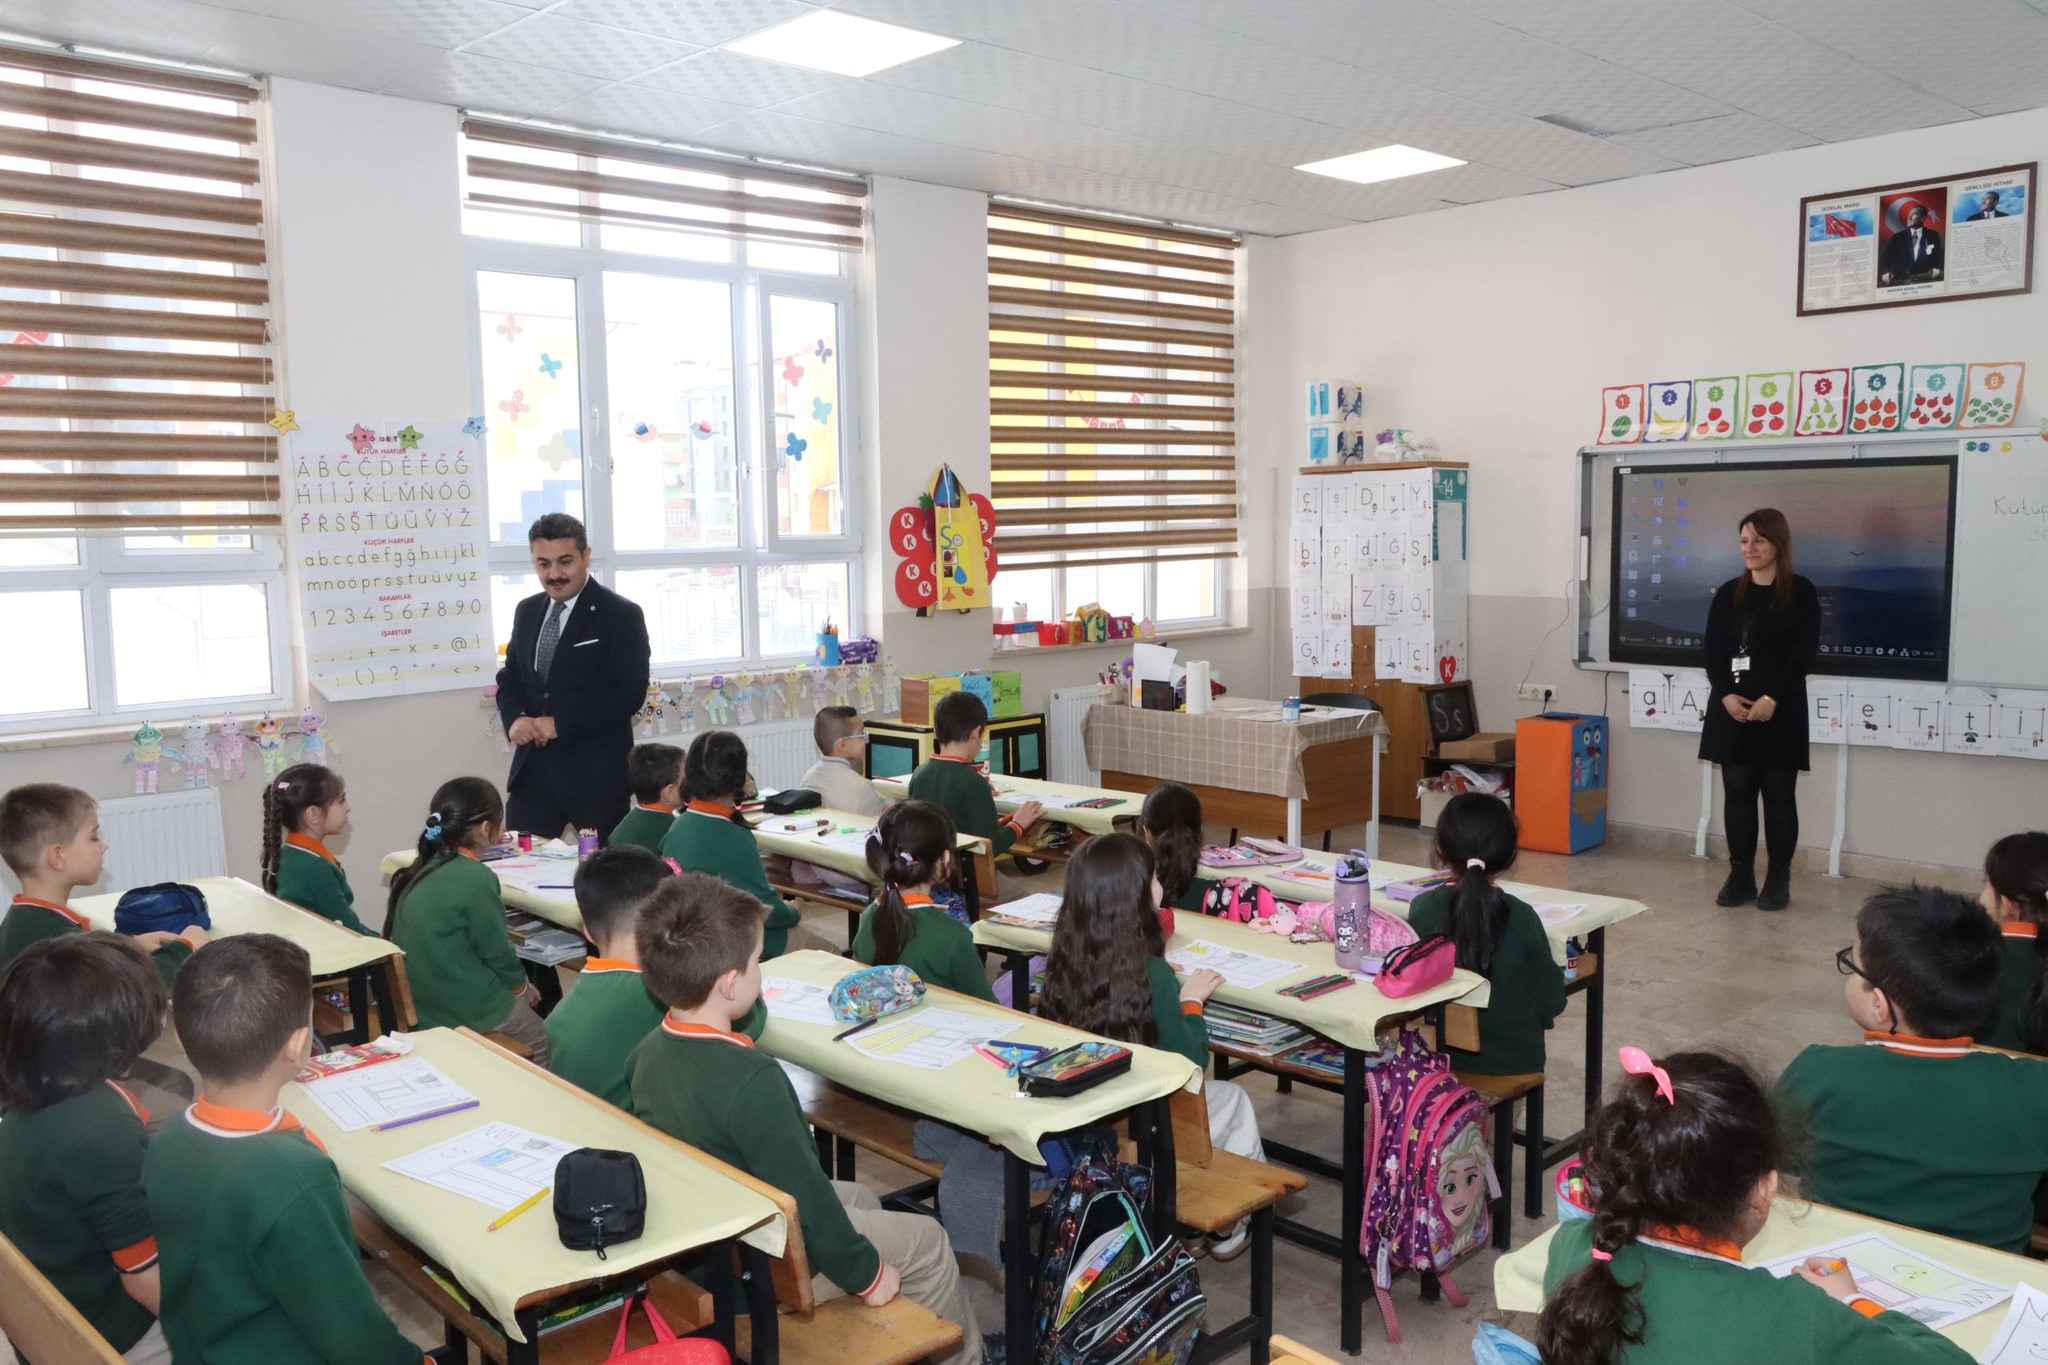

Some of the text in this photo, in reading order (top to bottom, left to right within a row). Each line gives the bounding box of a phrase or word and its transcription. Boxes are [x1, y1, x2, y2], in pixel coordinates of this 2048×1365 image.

[1820, 381, 1827, 392] 5
[1873, 378, 1881, 388] 6
[1933, 377, 1941, 387] 7
[1991, 377, 1998, 387] 8
[1712, 389, 1718, 399] 3
[1765, 385, 1772, 394] 4
[1620, 397, 1625, 406] 1
[1666, 393, 1672, 403] 2
[1443, 478, 1454, 497] 14
[1361, 487, 1373, 505] D
[1412, 487, 1421, 502] Y
[904, 515, 912, 527] K
[364, 537, 415, 546] KÜÇÜK HARFLER
[906, 536, 915, 549] K
[1361, 538, 1370, 556] d
[1301, 542, 1310, 560] b
[909, 566, 917, 578] K
[921, 582, 929, 595] K
[378, 593, 412, 602] RAKAMLAR
[1362, 590, 1374, 607] Z
[381, 628, 413, 638] İŞARETLER
[1301, 642, 1312, 658] G
[1445, 663, 1452, 677] K
[1643, 691, 1656, 706] a
[1681, 690, 1698, 712] A
[1817, 698, 1829, 719] E
[1862, 704, 1874, 717] e
[1913, 707, 1928, 728] T
[1965, 711, 1975, 730] t
